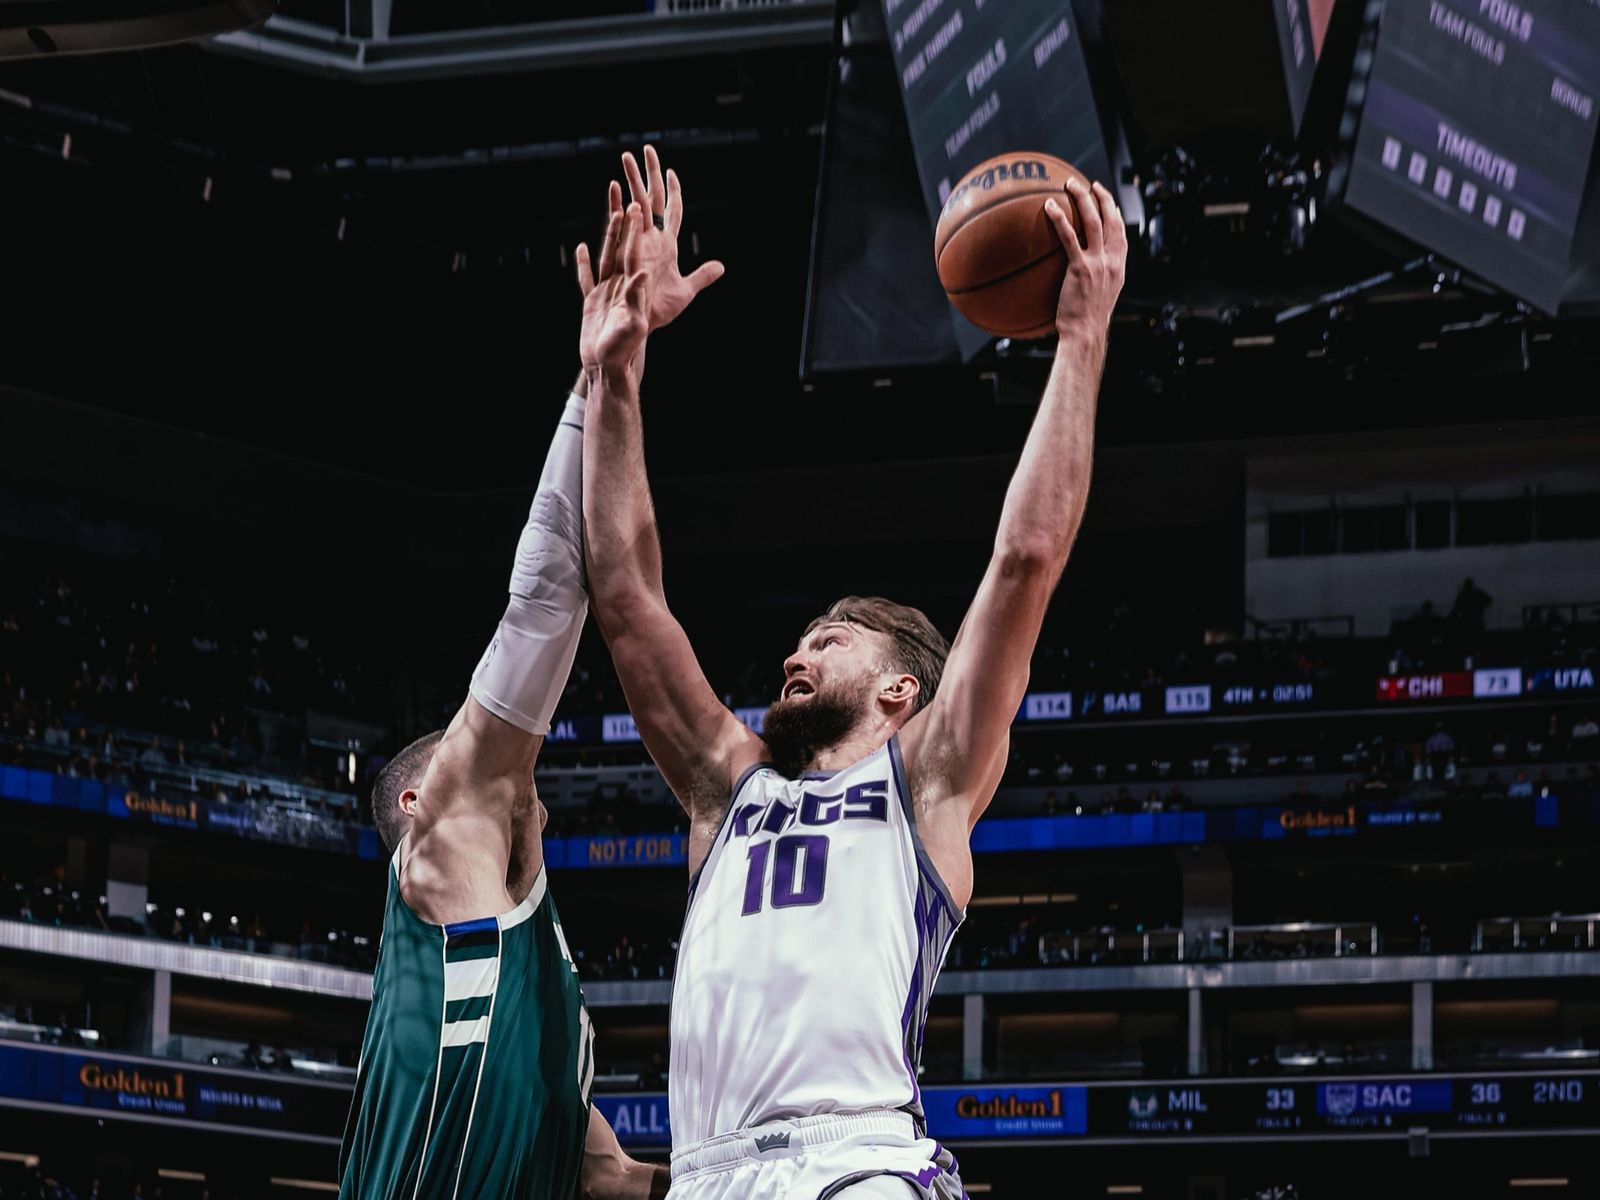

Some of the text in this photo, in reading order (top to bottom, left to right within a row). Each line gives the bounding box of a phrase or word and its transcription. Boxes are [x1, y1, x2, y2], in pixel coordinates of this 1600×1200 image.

[1464, 22, 1506, 67] FOULS
[966, 37, 1008, 99] FOULS
[1551, 76, 1593, 121] BONUS
[1437, 120, 1518, 192] TIMEOUTS
[1103, 691, 1142, 714] SAS
[1408, 674, 1443, 700] CHI
[1553, 667, 1595, 691] UTA
[740, 834, 831, 917] 10
[79, 1062, 170, 1097] Golden
[1167, 1088, 1209, 1113] MIL
[1265, 1087, 1296, 1110] 33
[1362, 1083, 1412, 1108] SAC
[1532, 1079, 1584, 1104] 2ND
[956, 1094, 1047, 1118] Golden
